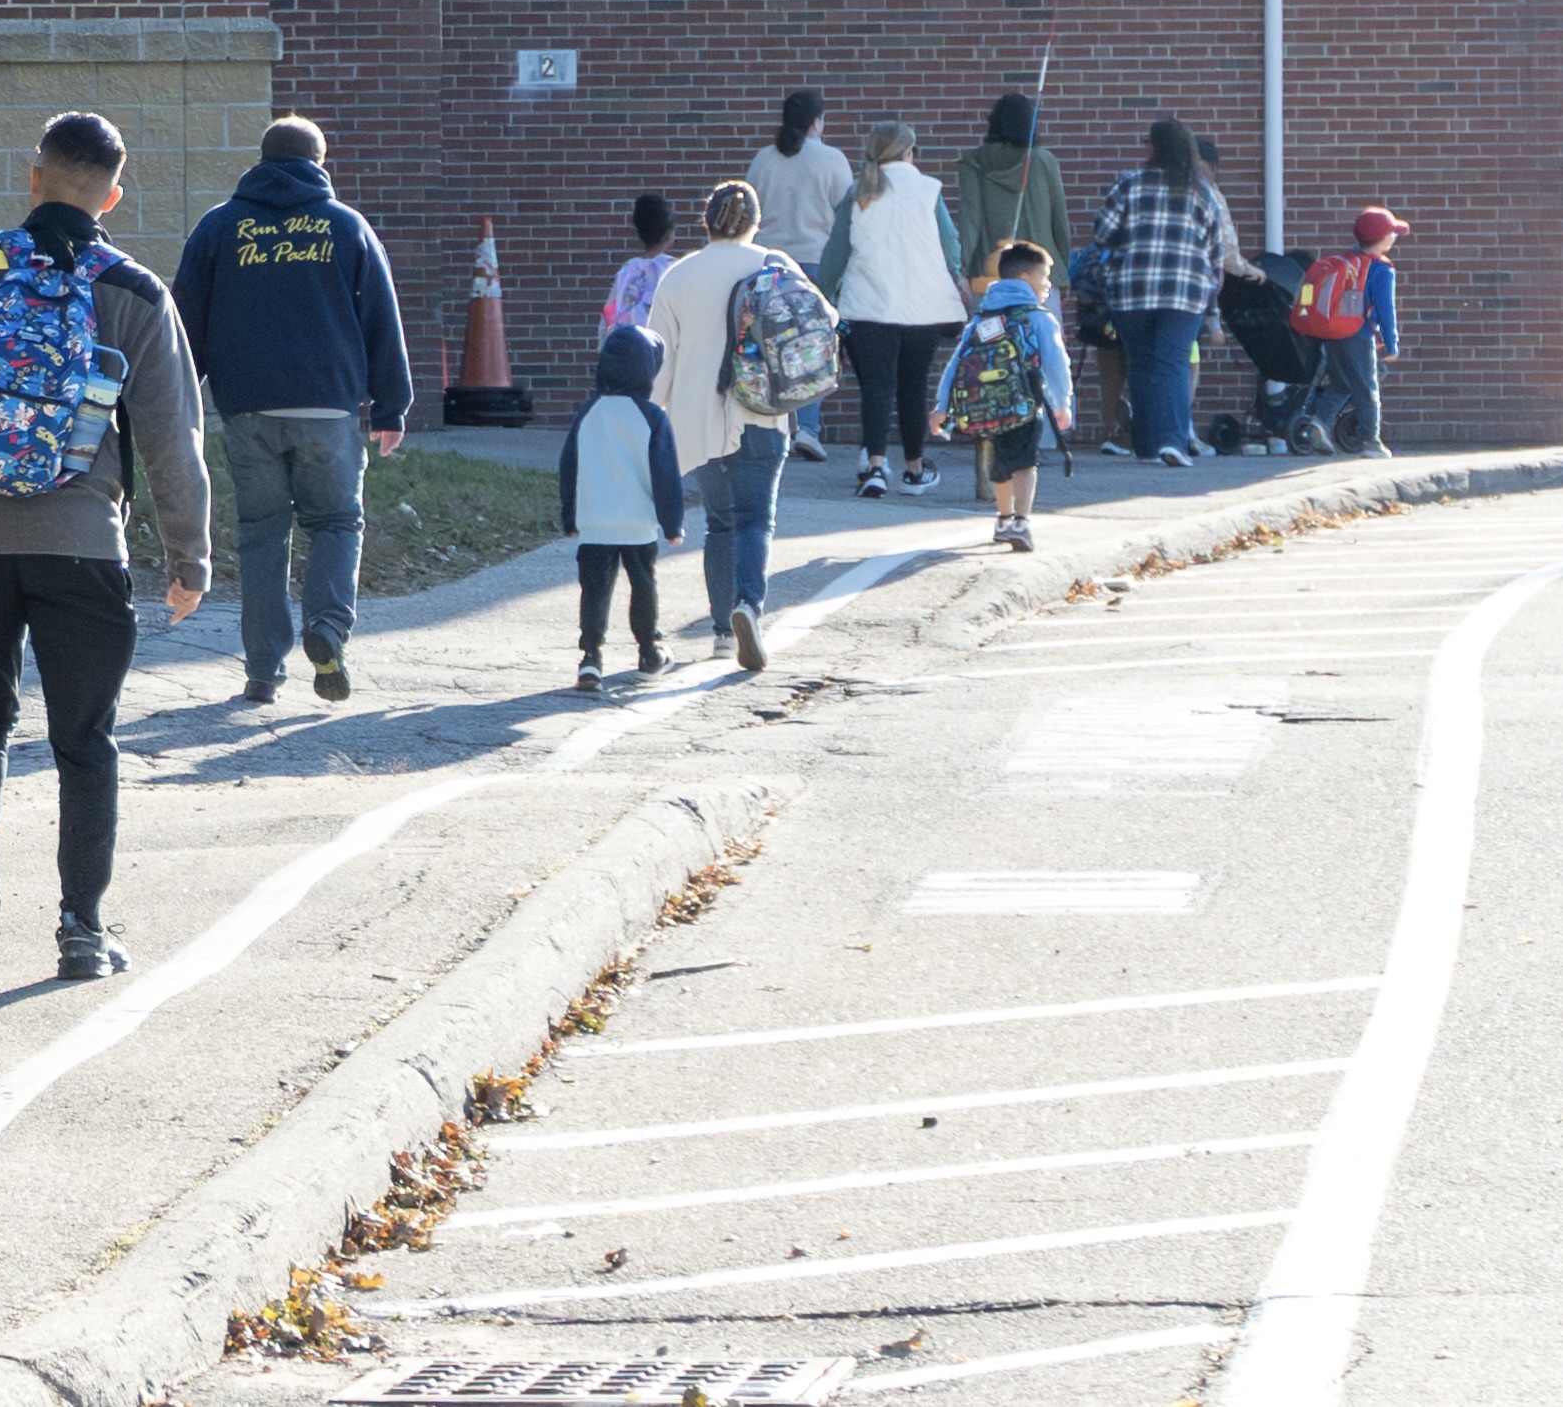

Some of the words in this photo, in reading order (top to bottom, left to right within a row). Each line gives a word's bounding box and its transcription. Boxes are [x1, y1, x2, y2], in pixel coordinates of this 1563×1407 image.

[542, 56, 555, 78] 2
[237, 218, 279, 240] Run
[284, 214, 332, 235] With
[237, 242, 268, 267] The
[272, 239, 334, 263] Pack!!
